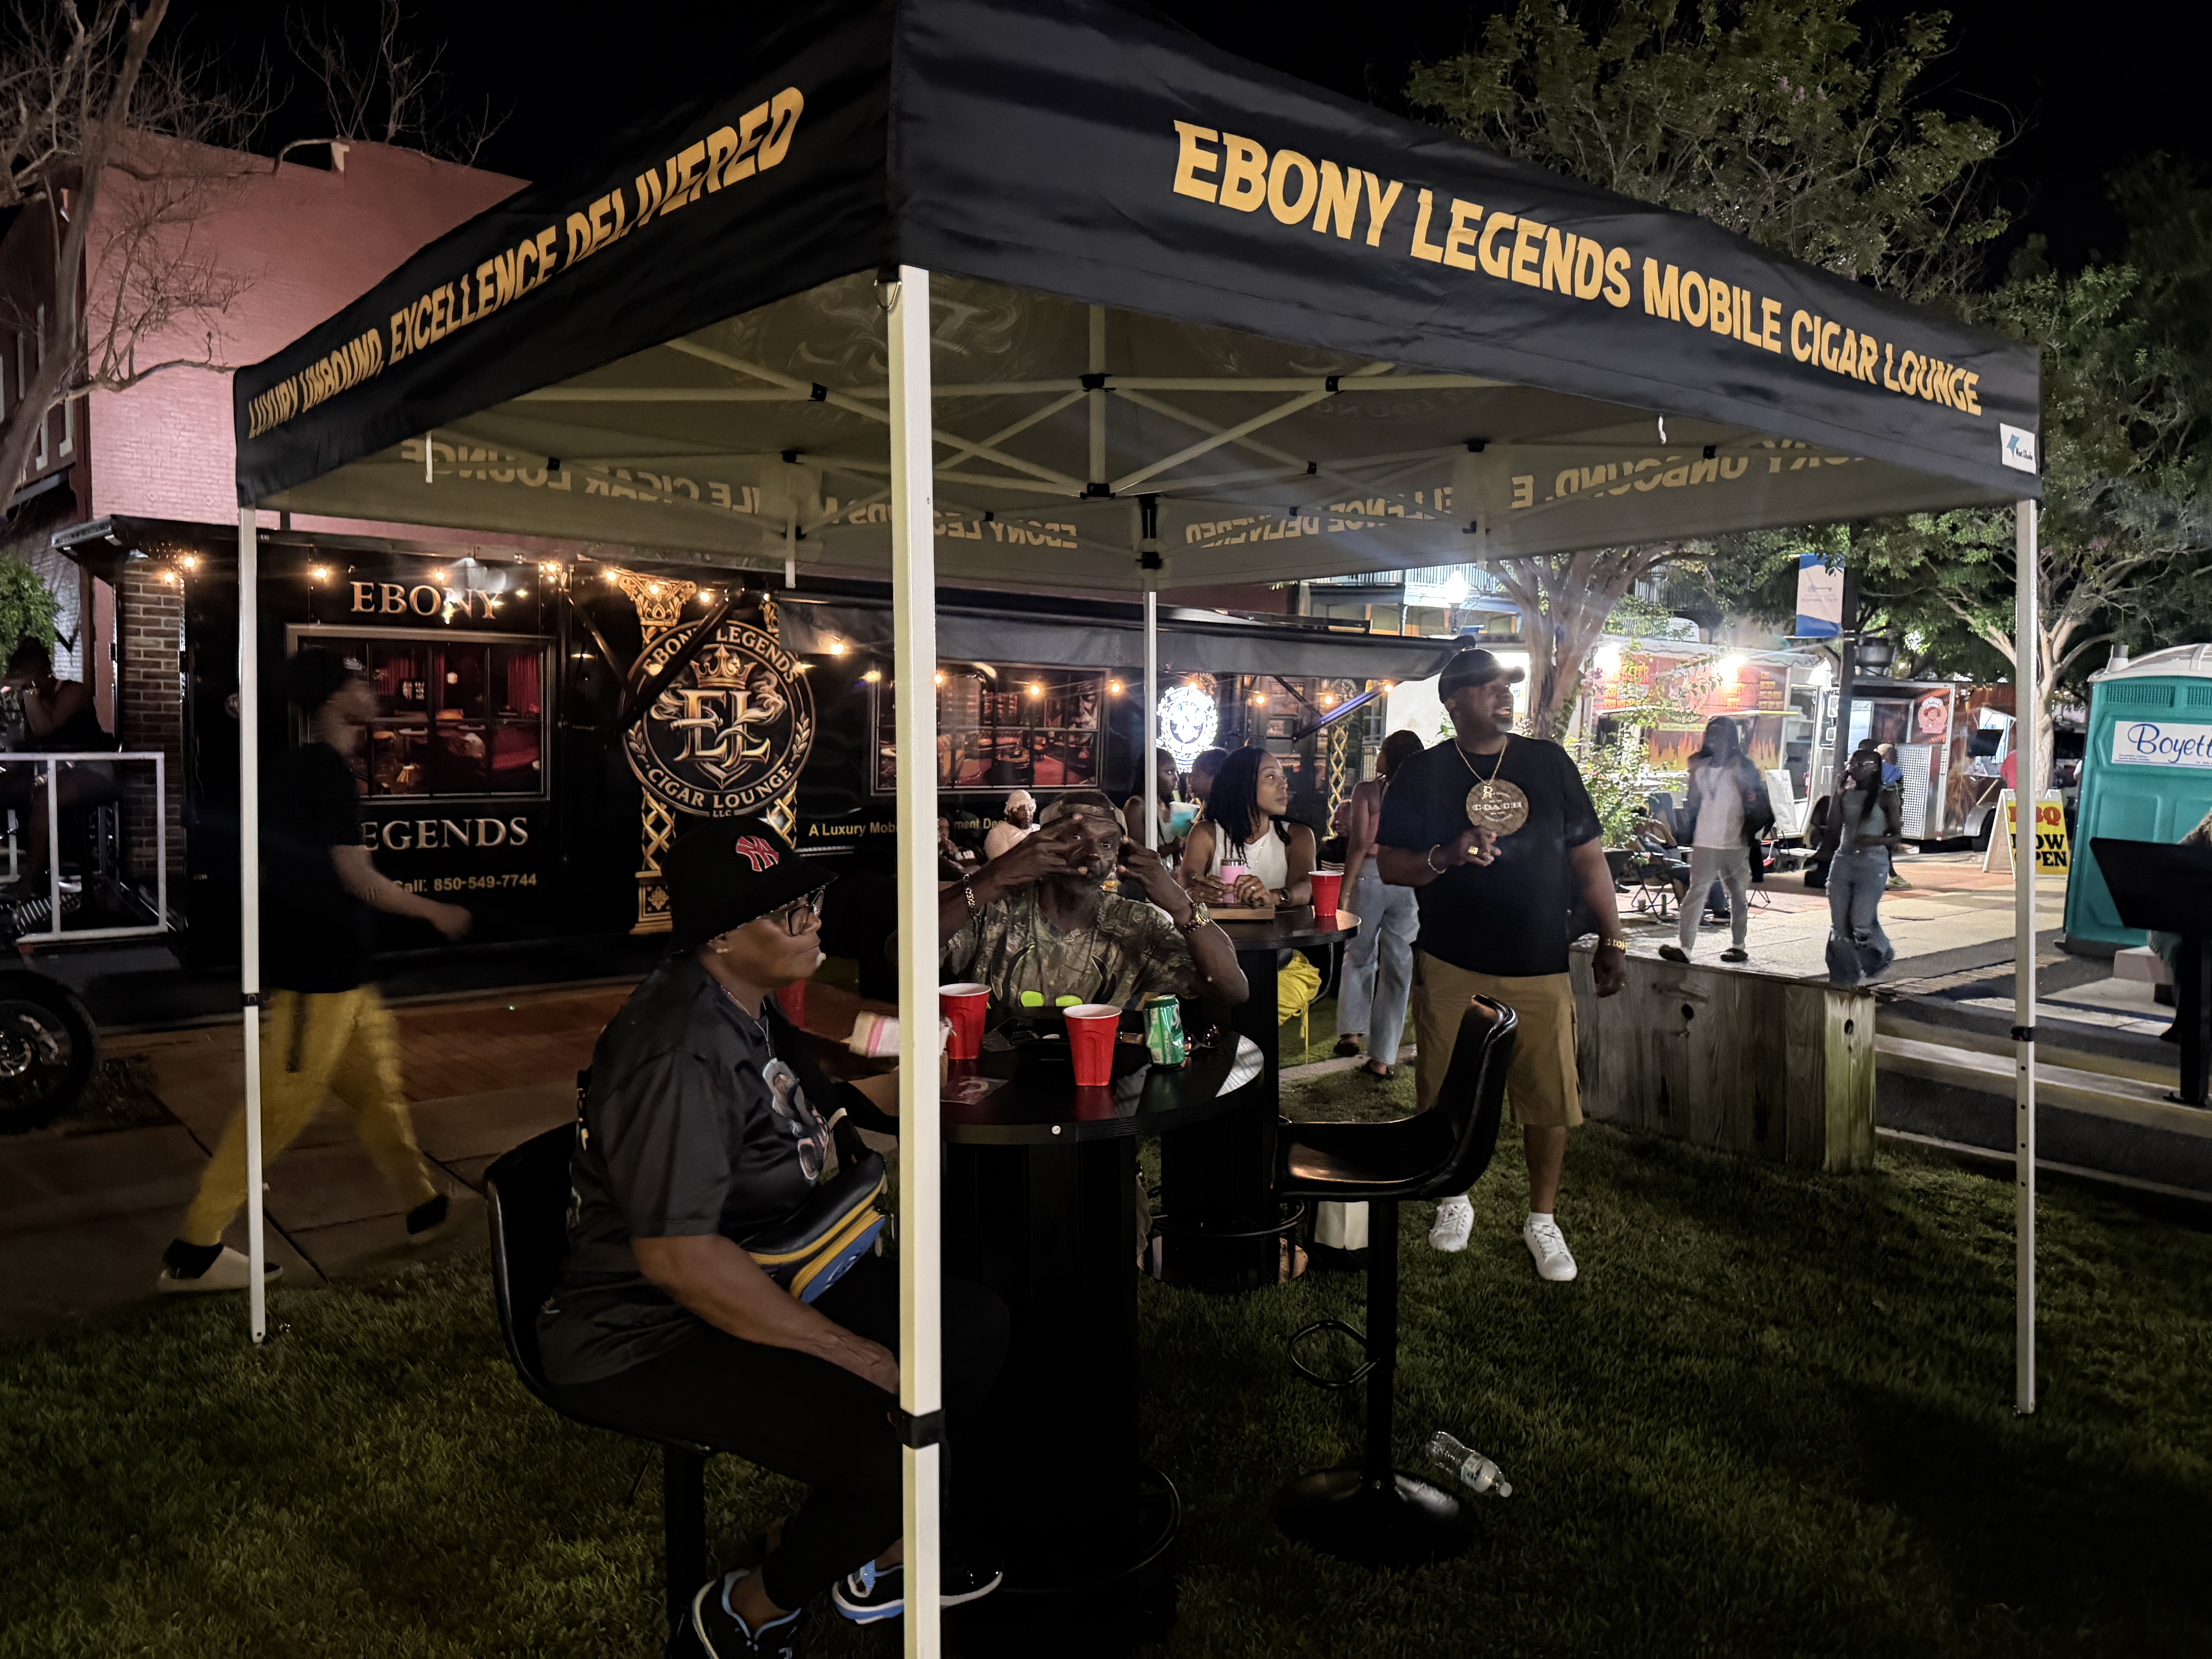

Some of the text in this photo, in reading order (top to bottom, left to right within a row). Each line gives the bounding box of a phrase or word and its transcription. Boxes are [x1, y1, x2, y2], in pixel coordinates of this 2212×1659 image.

[249, 87, 804, 439] LUXURY UNBOUND, EXCELLENCE DELIVERED
[1174, 120, 1982, 416] EBONY LEGENDS MOBILE CIGAR LOUNGE
[350, 580, 503, 619] EBONY
[716, 625, 799, 684] LEGENDS
[647, 766, 792, 809] CIGAR LOUNGE
[713, 809, 732, 817] LLC
[1472, 801, 1523, 812] COACH
[361, 816, 529, 852] EGENDS
[809, 824, 819, 837] A
[822, 823, 866, 837] Luxury
[870, 821, 897, 834] Mob
[434, 873, 537, 891] 850-549-7744
